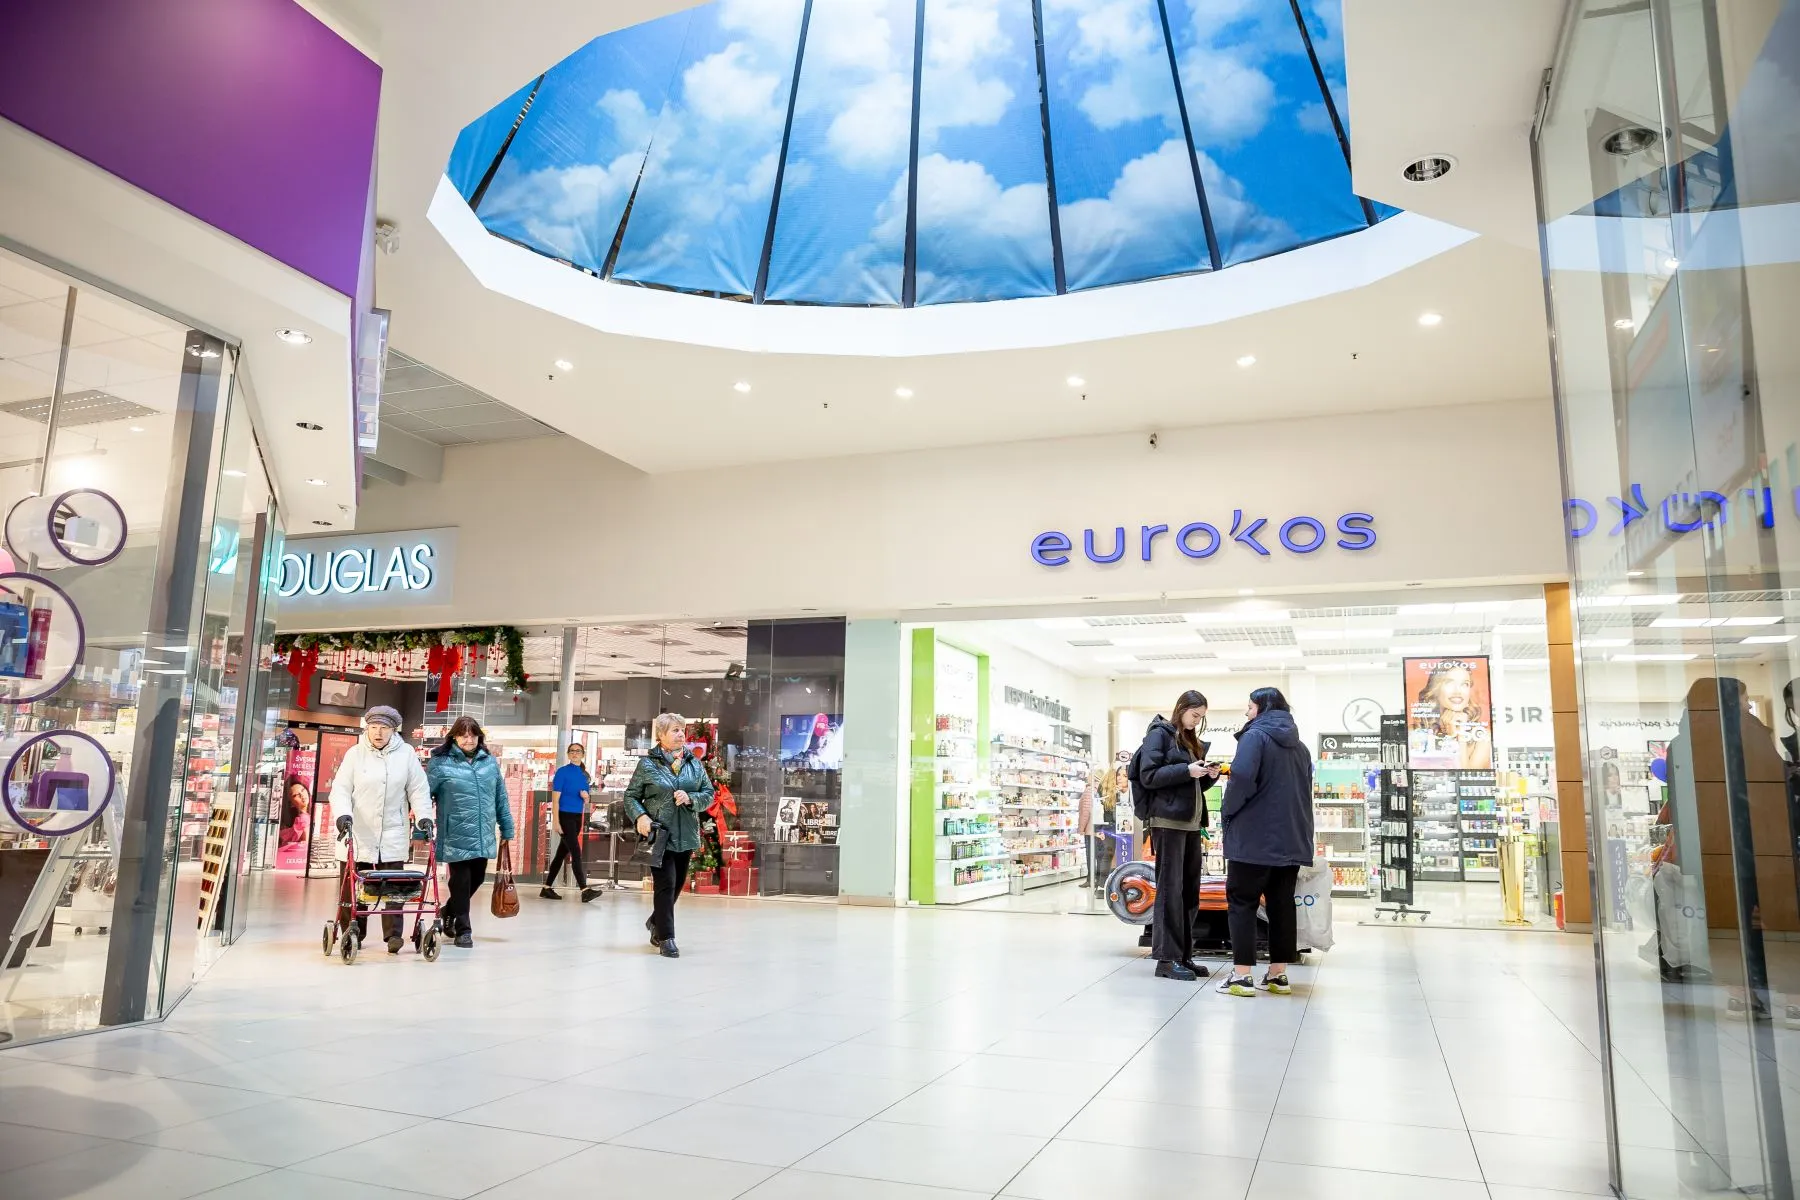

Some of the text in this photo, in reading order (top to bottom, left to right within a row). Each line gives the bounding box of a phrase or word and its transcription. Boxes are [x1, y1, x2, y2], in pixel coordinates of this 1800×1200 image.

[1030, 509, 1377, 567] eurokos
[279, 543, 433, 597] OUGLAS
[1419, 660, 1477, 670] eurokos
[1521, 706, 1543, 723] IR
